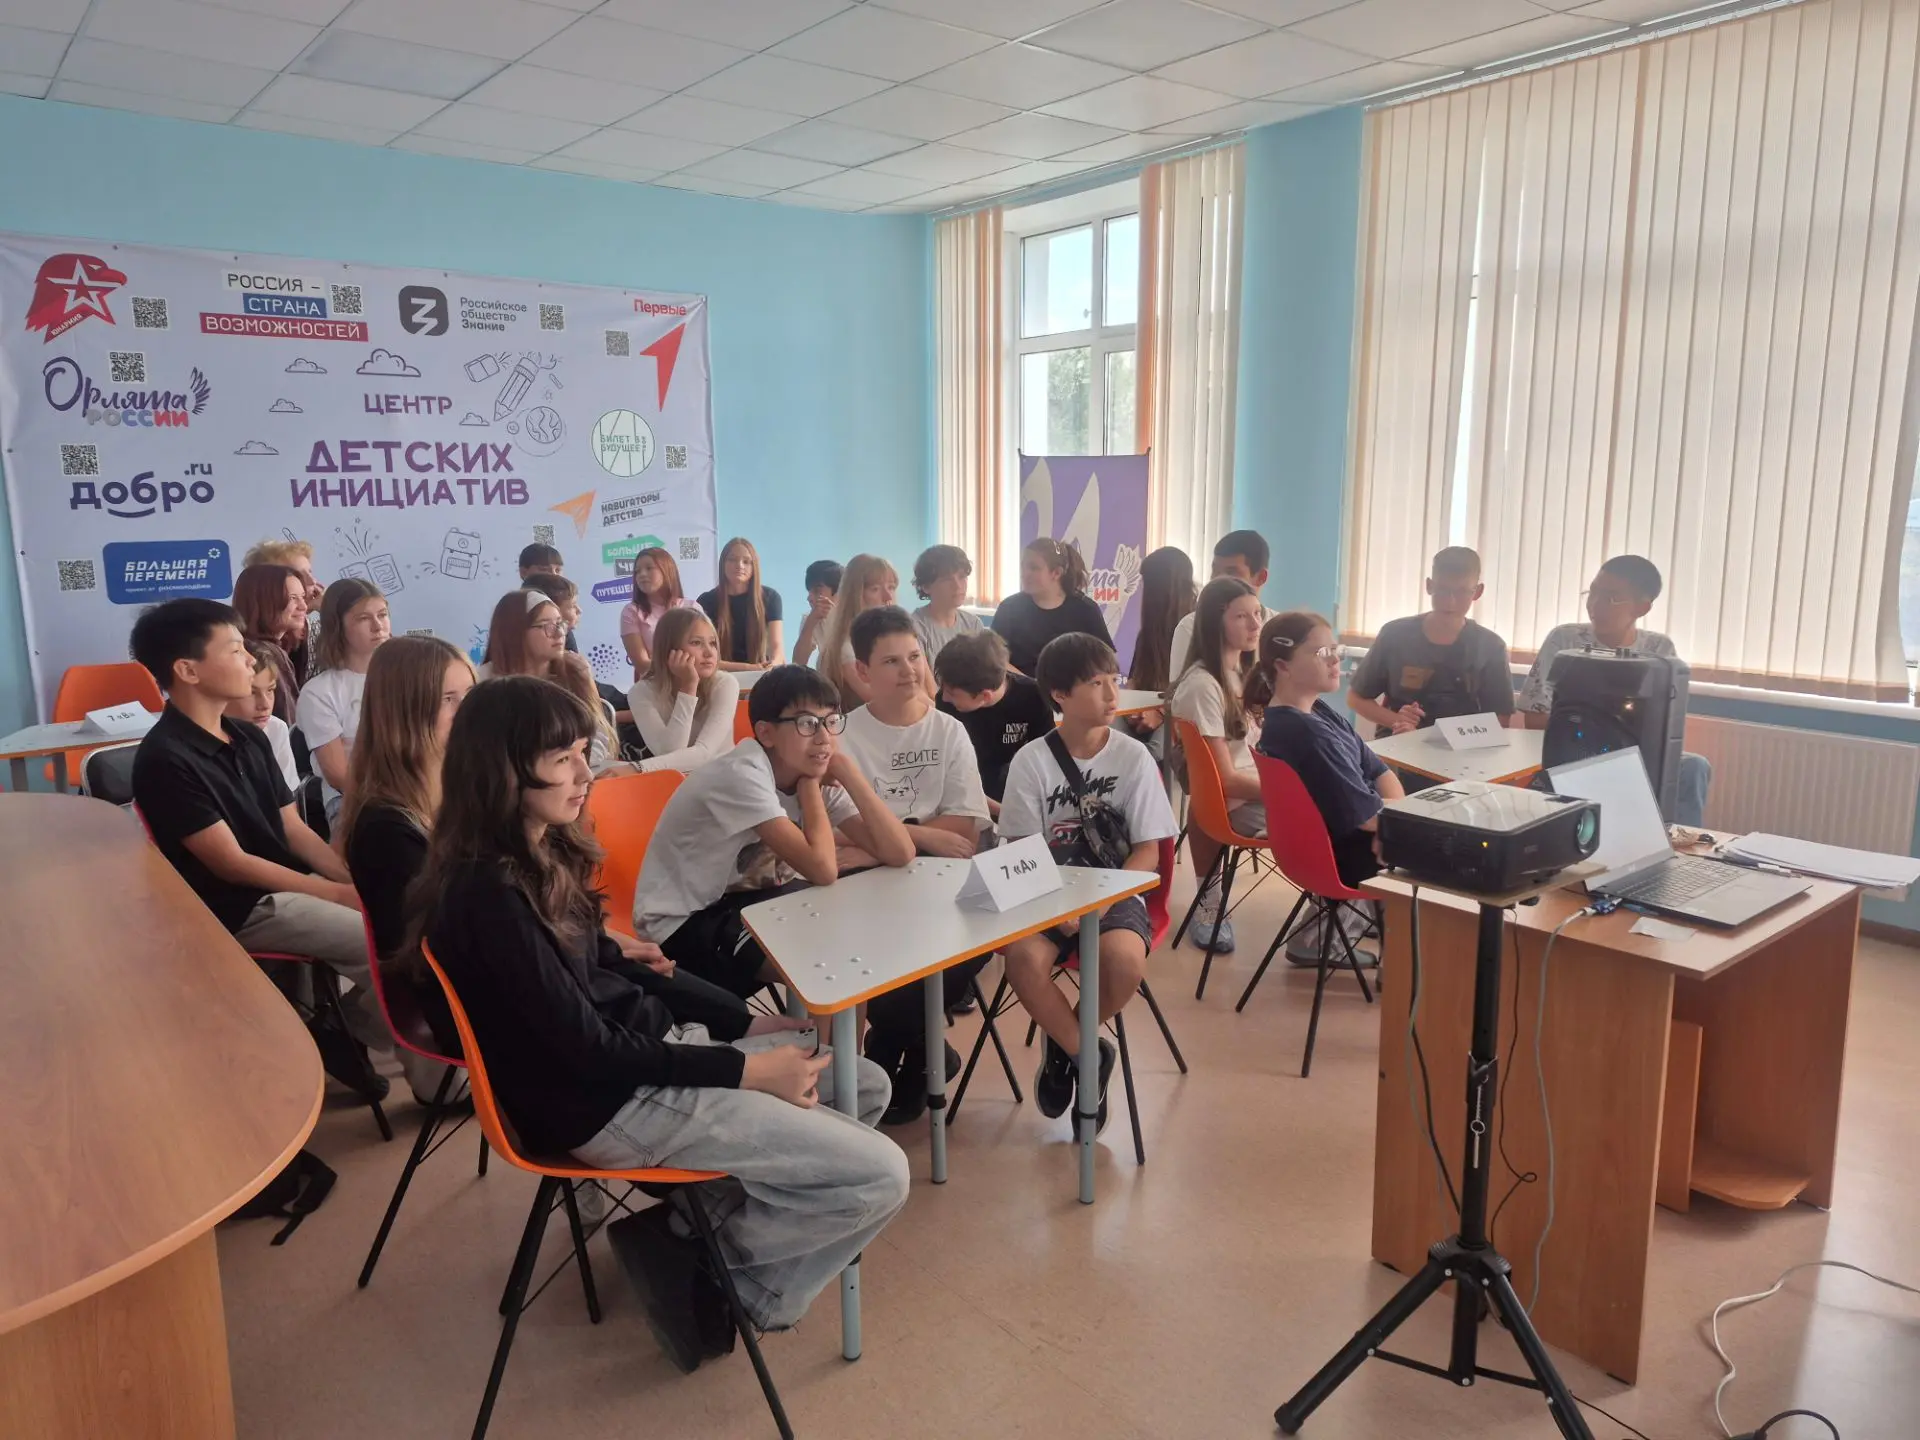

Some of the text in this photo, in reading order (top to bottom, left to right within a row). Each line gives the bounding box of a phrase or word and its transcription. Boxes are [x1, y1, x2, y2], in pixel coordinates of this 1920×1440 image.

[227, 273, 303, 292] РОССИЯ
[248, 298, 321, 316] СТРАНА
[460, 297, 527, 312] Российское
[634, 299, 686, 317] Первые
[461, 309, 517, 322] общество
[205, 316, 360, 339] ВОЗМОЖНОСТЕЙ
[462, 319, 505, 331] Знание
[43, 356, 190, 418] Орлята
[363, 393, 453, 416] ЦЕНТР
[600, 435, 630, 443] БИЛЕТ
[601, 444, 640, 452] БУДУЩЕЕ
[305, 440, 514, 473] ДЕТСКИХ
[70, 471, 215, 513] добро
[290, 478, 530, 509] ИНИЦИАТИВ
[601, 492, 660, 513] НАВИГАТОРЫ
[603, 508, 643, 527] ДЕТСТВА
[125, 559, 208, 571] БОЛЬШАЯ
[125, 569, 207, 582] ПЕРЕМЕНА
[596, 583, 634, 597] ПУТЕШЕ
[892, 749, 939, 767] БЕСИТЕ
[1000, 865, 1009, 880] 7
